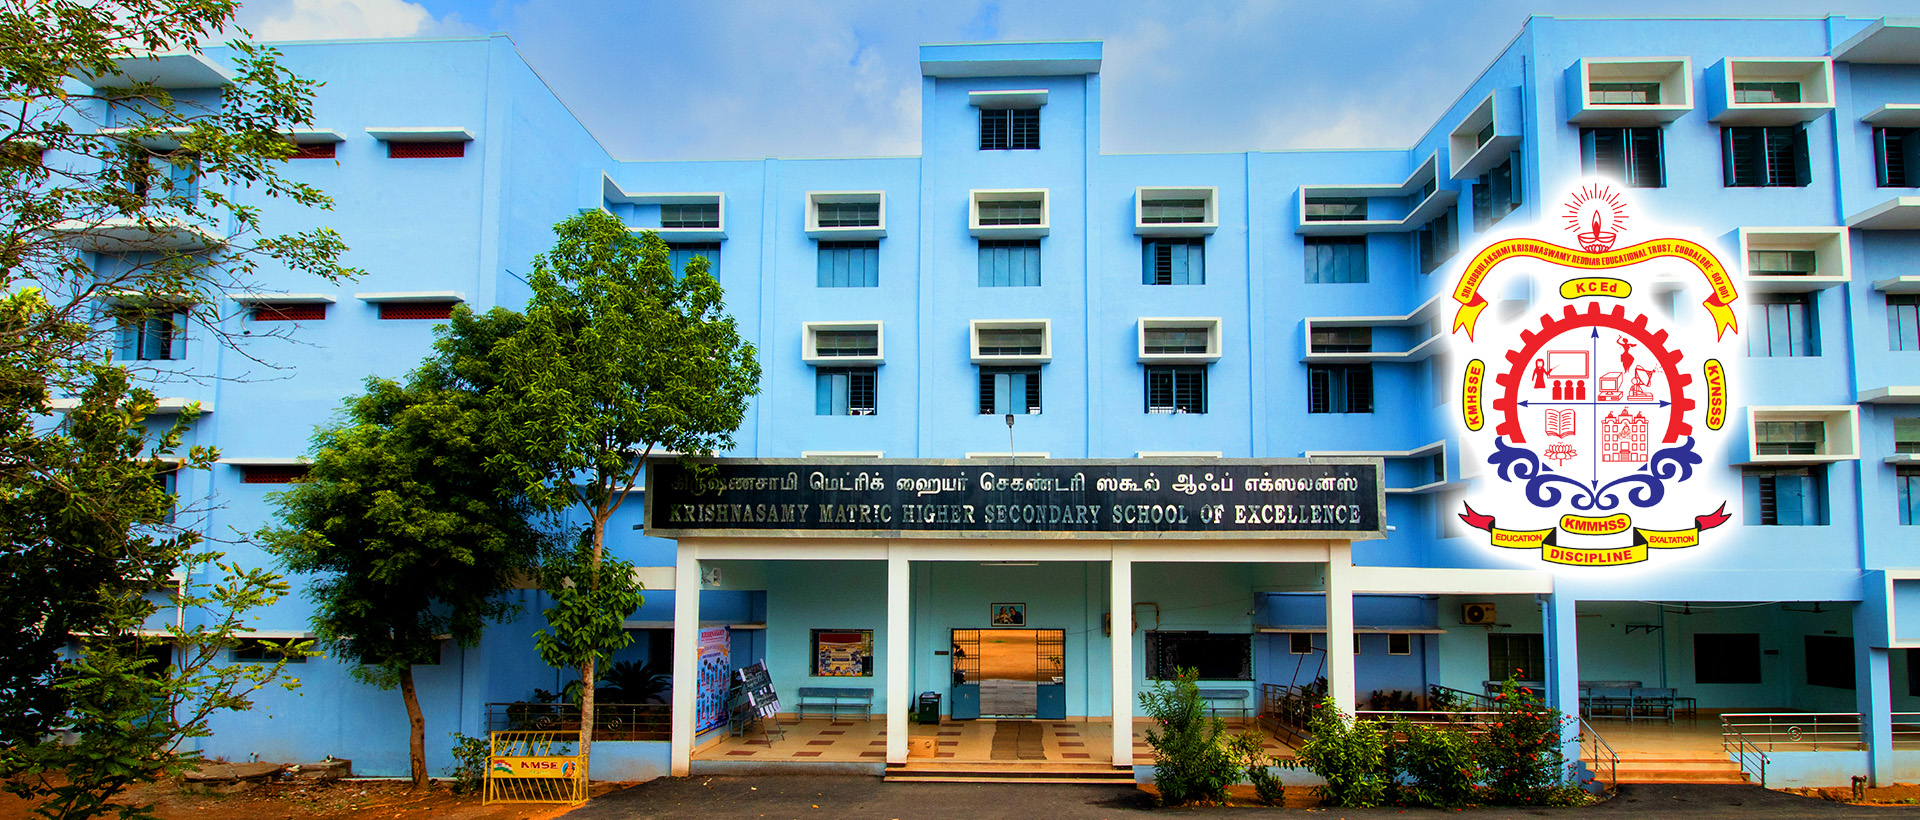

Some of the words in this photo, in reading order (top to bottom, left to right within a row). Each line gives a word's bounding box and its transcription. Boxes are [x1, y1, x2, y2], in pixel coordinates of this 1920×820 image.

[809, 471, 885, 491] மெட்ரிக்
[896, 471, 968, 497] ஹையர்
[979, 471, 1086, 491] செகண்டரி
[1096, 471, 1161, 492] ஸ்கூல்
[1171, 471, 1233, 495] ஆஃப்
[1245, 471, 1359, 492] எக்ஸலன்ஸ்
[669, 504, 810, 523] KRISHNASAMY
[818, 504, 892, 523] MATRIC
[902, 504, 976, 523] HIGHER
[984, 504, 1101, 524] SECONDARY
[1112, 504, 1189, 524] SCHOOL
[1200, 503, 1225, 524] OF
[1234, 504, 1362, 524] EXCELLENCE
[521, 761, 559, 769] KMSE
